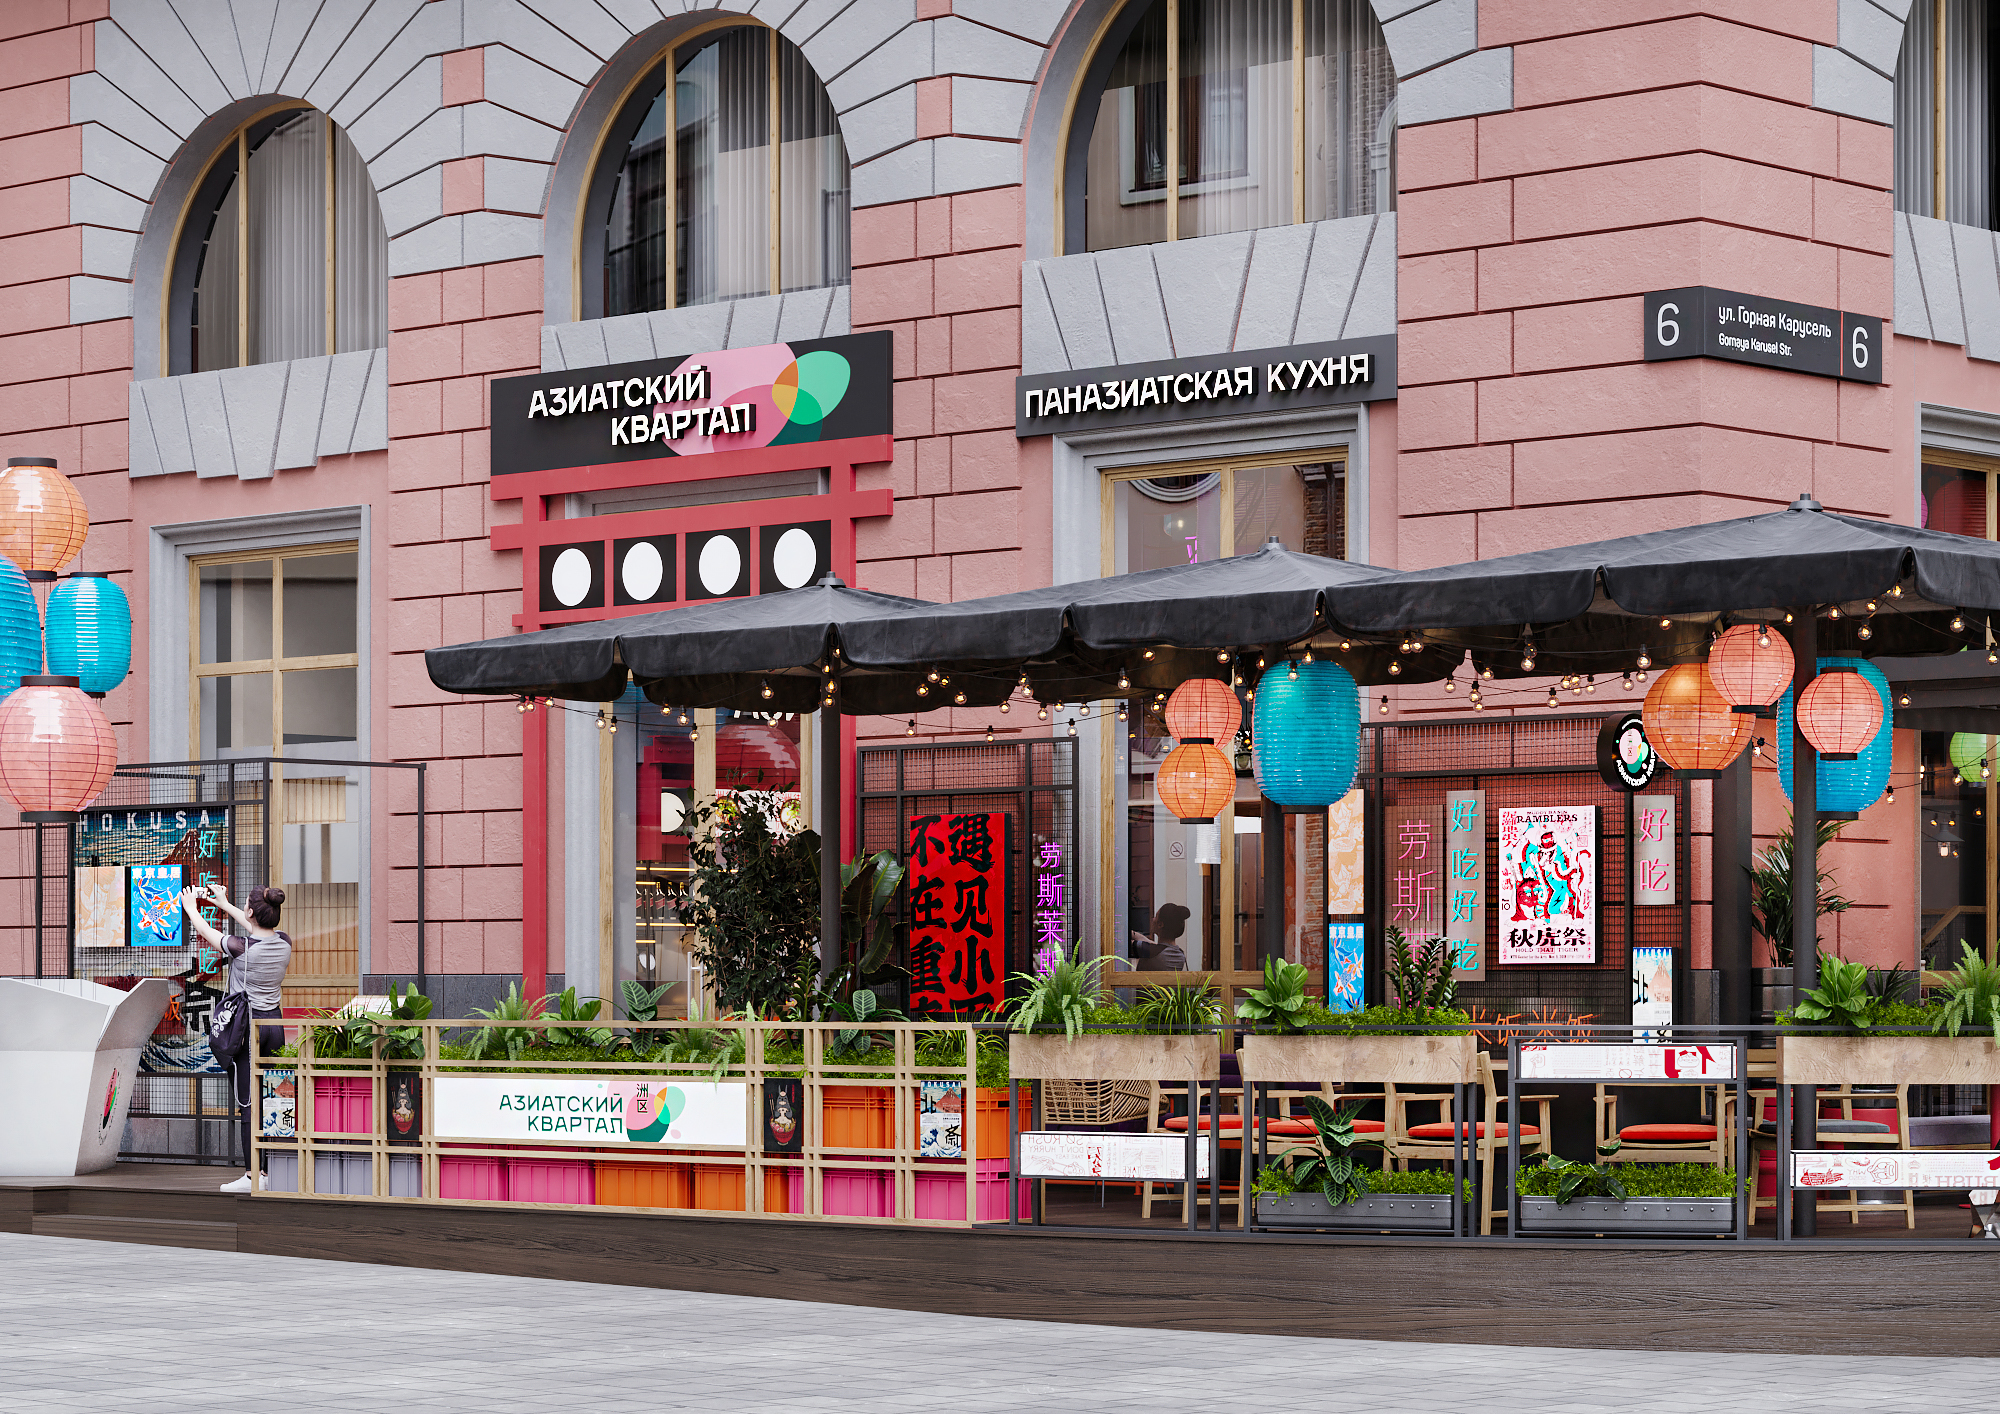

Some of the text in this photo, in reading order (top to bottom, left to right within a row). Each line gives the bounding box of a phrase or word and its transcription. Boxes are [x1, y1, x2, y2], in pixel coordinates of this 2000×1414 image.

[1656, 302, 1680, 347] 6
[1718, 305, 1832, 339] ул. Горная Карусель
[1750, 337, 1778, 355] Karusel
[1779, 341, 1793, 357] Str.
[1852, 326, 1869, 369] 6
[528, 365, 708, 419] АЗИАТСКИЙ
[1025, 353, 1371, 419] ПАНАЗИАТСКАЯ КУХНЯ
[610, 402, 752, 446] КВАРТАЛ
[78, 808, 229, 832] HOKUSAI
[1517, 813, 1578, 823] RAMBLERS
[1637, 807, 1670, 893] 好吃
[1450, 799, 1479, 971] 好吃好吃
[910, 815, 948, 1012] 不在重
[1507, 926, 1587, 949] 秋虎祭
[1632, 948, 1673, 959] HOKUSAI
[499, 1092, 623, 1114] АЗИАТСКИЙ
[527, 1116, 623, 1134] КВАРТАЛ
